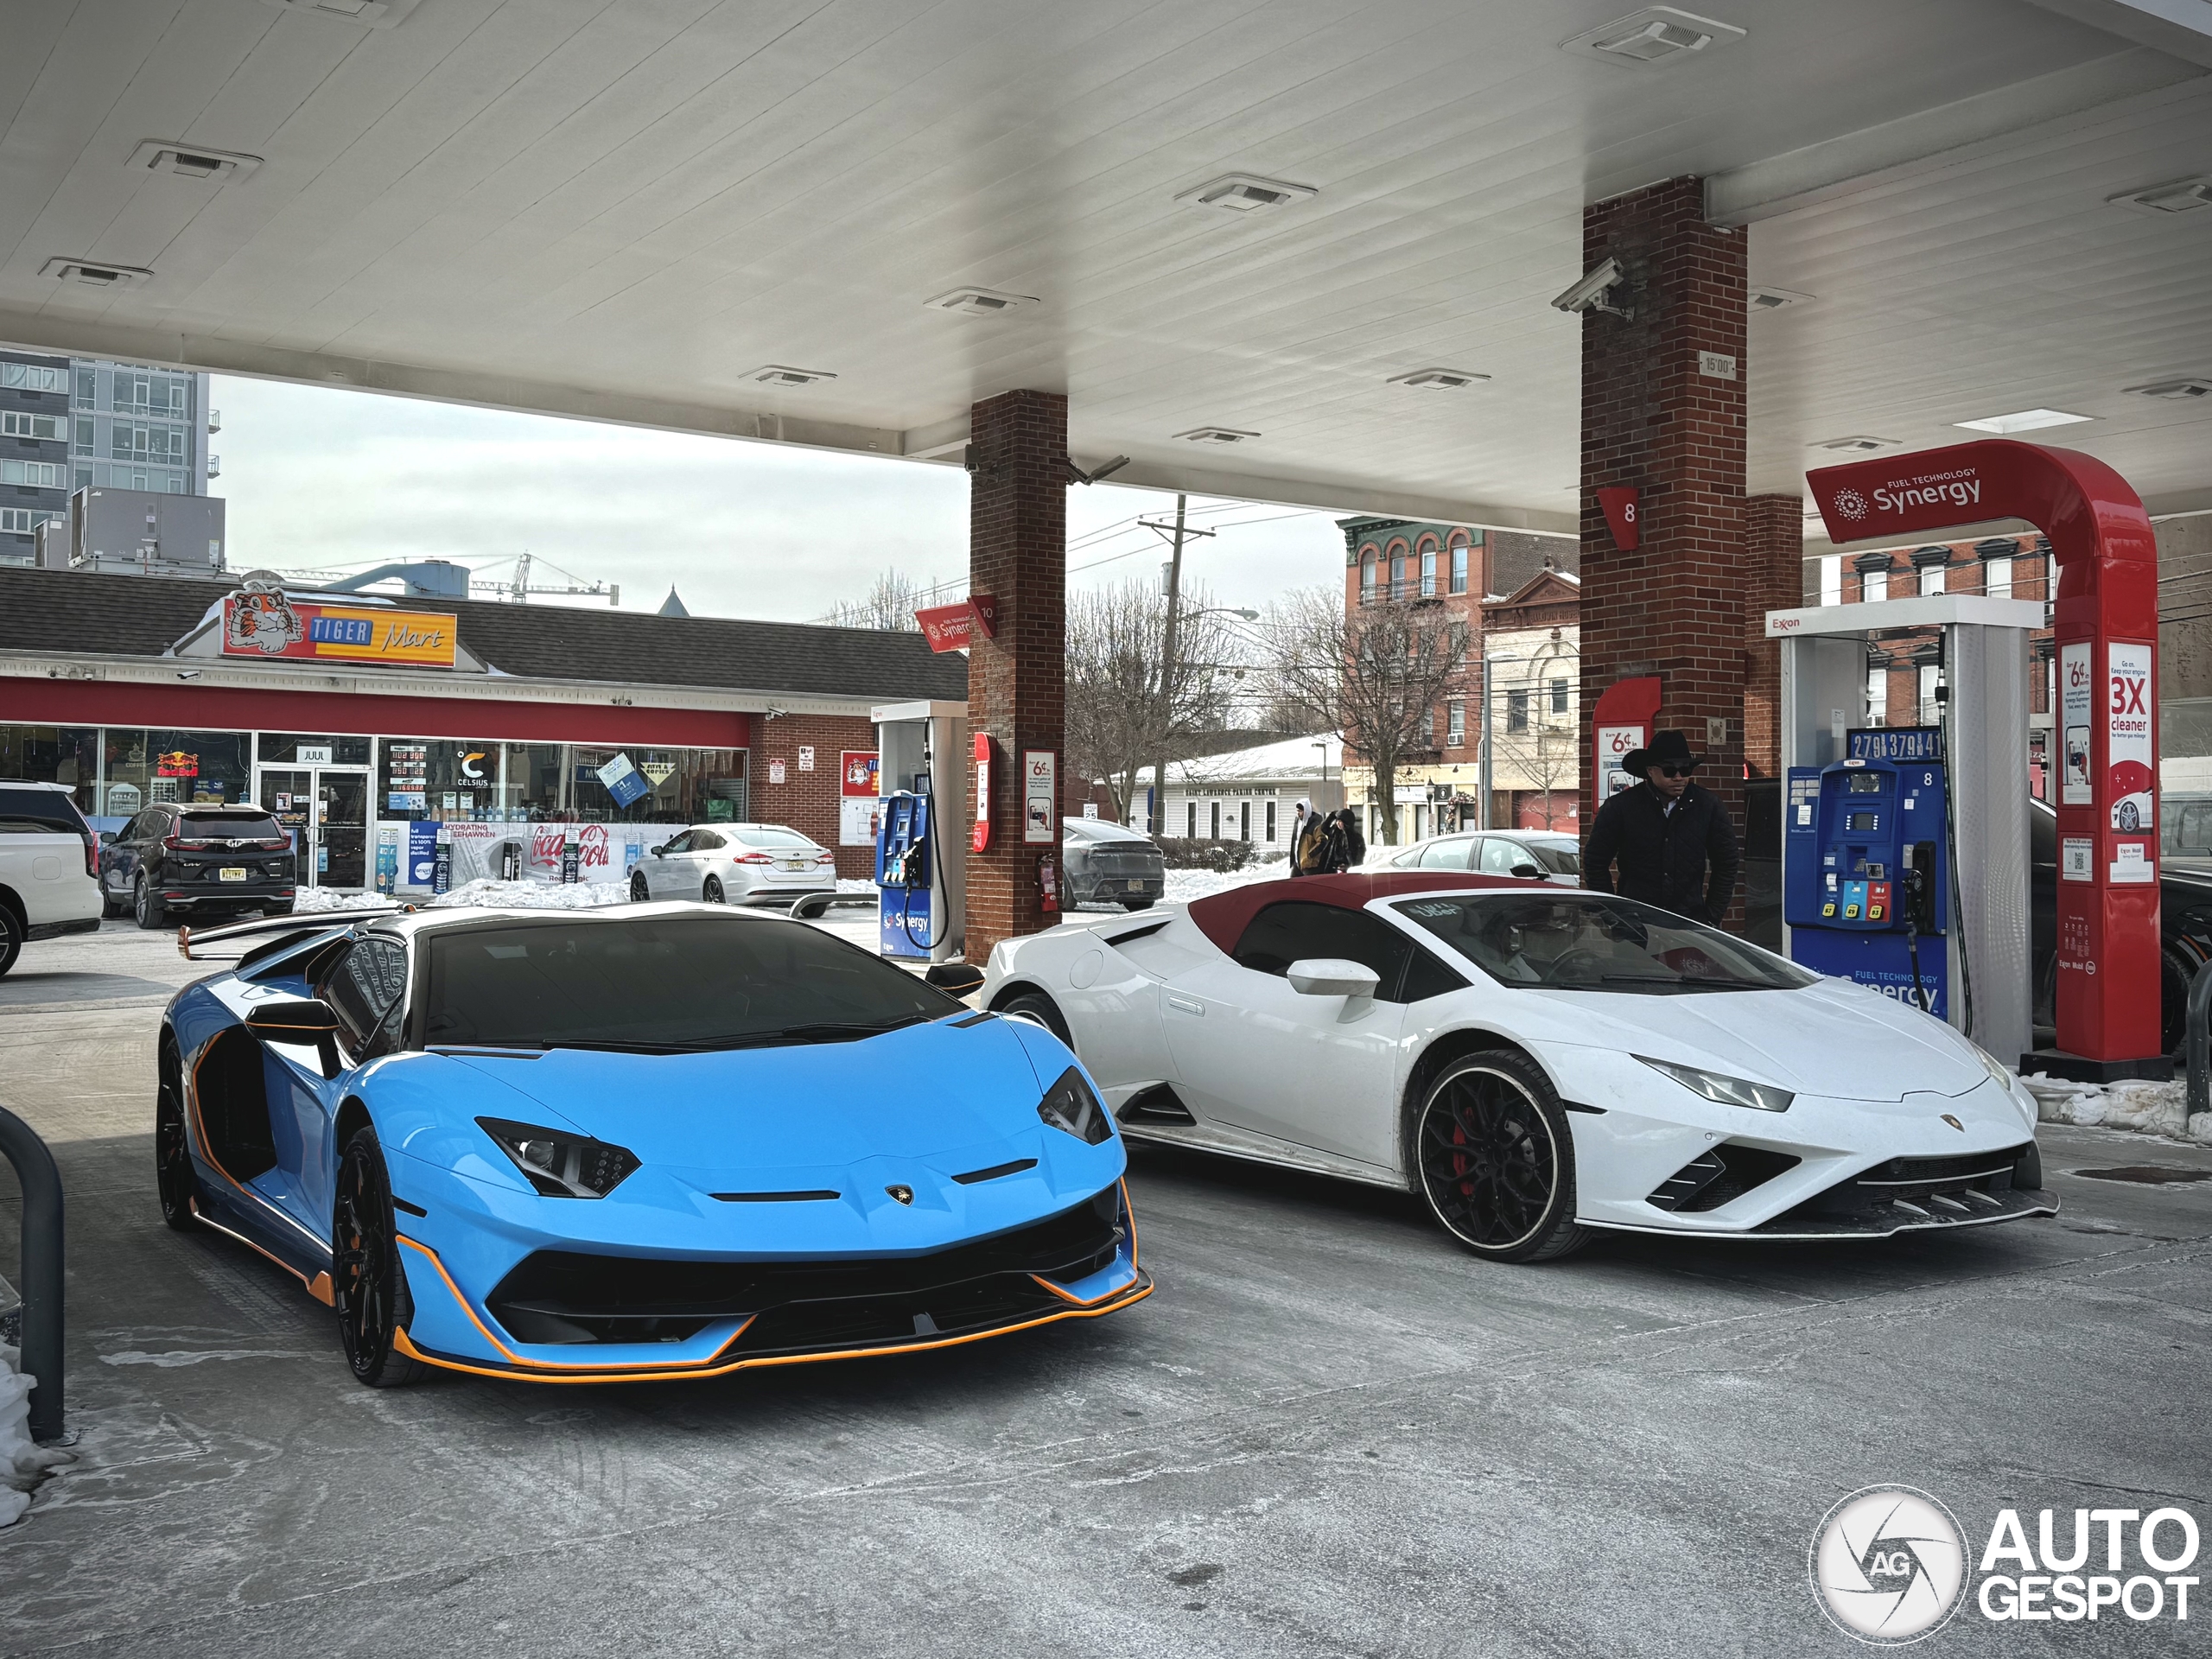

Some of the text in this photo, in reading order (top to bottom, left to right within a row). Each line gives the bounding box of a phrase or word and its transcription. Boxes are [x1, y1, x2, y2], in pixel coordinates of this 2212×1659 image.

[1887, 467, 1976, 489] FUEL TECHNOLOGY
[1873, 479, 1980, 515] Synergy
[1624, 503, 1635, 523] 8
[982, 607, 993, 618] 10
[1772, 619, 1800, 631] Exxon
[314, 618, 446, 652] TIGER Mart
[2132, 669, 2146, 677] engine
[2111, 677, 2146, 715] 3X
[2111, 715, 2147, 732] cleaner
[1611, 732, 1631, 753] 6¢
[1854, 734, 1880, 759] 279
[1890, 734, 1916, 758] 379
[1925, 733, 1942, 756] 41
[304, 751, 324, 760] JUUL
[458, 779, 489, 787] CELSIUS
[1923, 772, 1933, 786] 8
[1255, 787, 1276, 796] CENTER
[1855, 970, 1938, 984] FUEL TECHNOOGY
